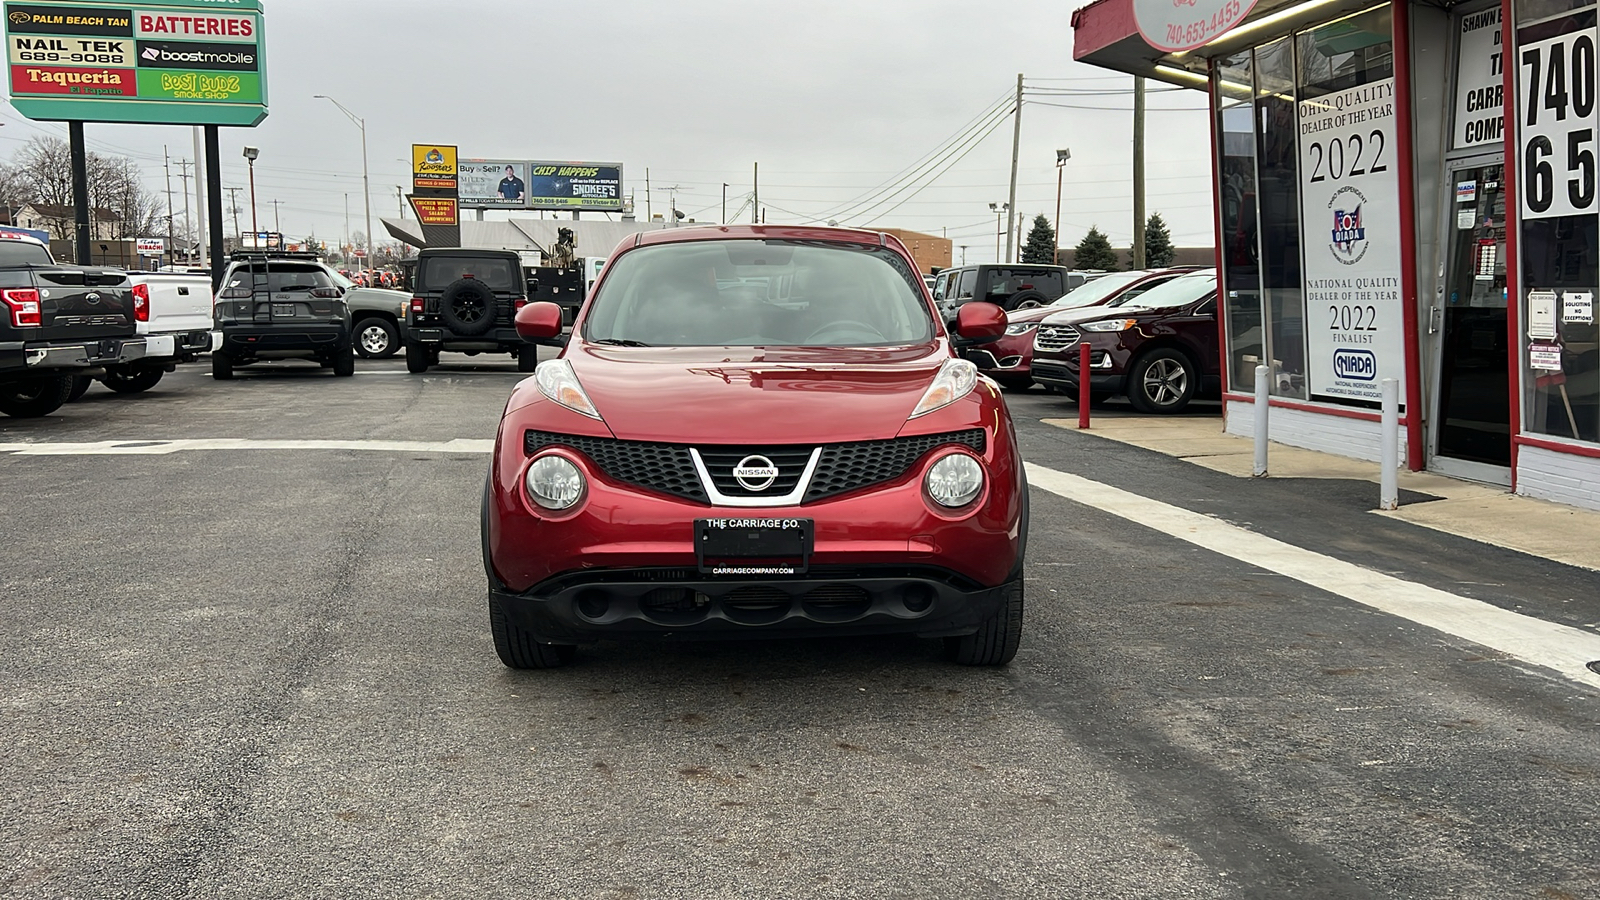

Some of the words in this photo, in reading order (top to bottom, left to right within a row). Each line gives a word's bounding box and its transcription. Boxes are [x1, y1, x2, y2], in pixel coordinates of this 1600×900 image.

[32, 15, 63, 24] PALM
[66, 16, 103, 25] BEACH
[107, 18, 128, 26] TAN
[140, 15, 252, 36] BATTERIES
[1166, 0, 1240, 44] 740-653-4455
[1463, 10, 1496, 33] SHAWN
[16, 39, 68, 50] NAIL
[77, 41, 124, 53] TEK
[20, 52, 123, 63] 689-9088
[27, 69, 121, 86] Taqueria
[1522, 35, 1595, 126] 740
[83, 87, 122, 95] Tapatio
[1300, 99, 1330, 118] OHIO
[1336, 82, 1393, 111] QUALITY
[1302, 114, 1333, 135] DEALER
[1335, 114, 1346, 127] OF
[1348, 110, 1366, 125] THE
[1368, 103, 1393, 120] YEAR
[1310, 129, 1387, 183] 2022
[418, 161, 452, 172] Roosters
[533, 166, 557, 176] CHIP
[558, 167, 599, 177] HAPPENS
[1336, 230, 1359, 241] OIADA
[1308, 279, 1353, 288] NATIONAL
[1356, 278, 1398, 289] QUALITY
[1309, 292, 1339, 300] DEALER
[1342, 292, 1352, 300] OF
[1356, 292, 1372, 300] THE
[1375, 291, 1398, 300] YEAR
[1329, 305, 1377, 331] 2022
[1333, 334, 1373, 344] FINALIST
[1337, 355, 1372, 376] NIADA
[707, 519, 727, 528] THE
[728, 519, 781, 528] CARRIAGE
[782, 519, 799, 528] CO.
